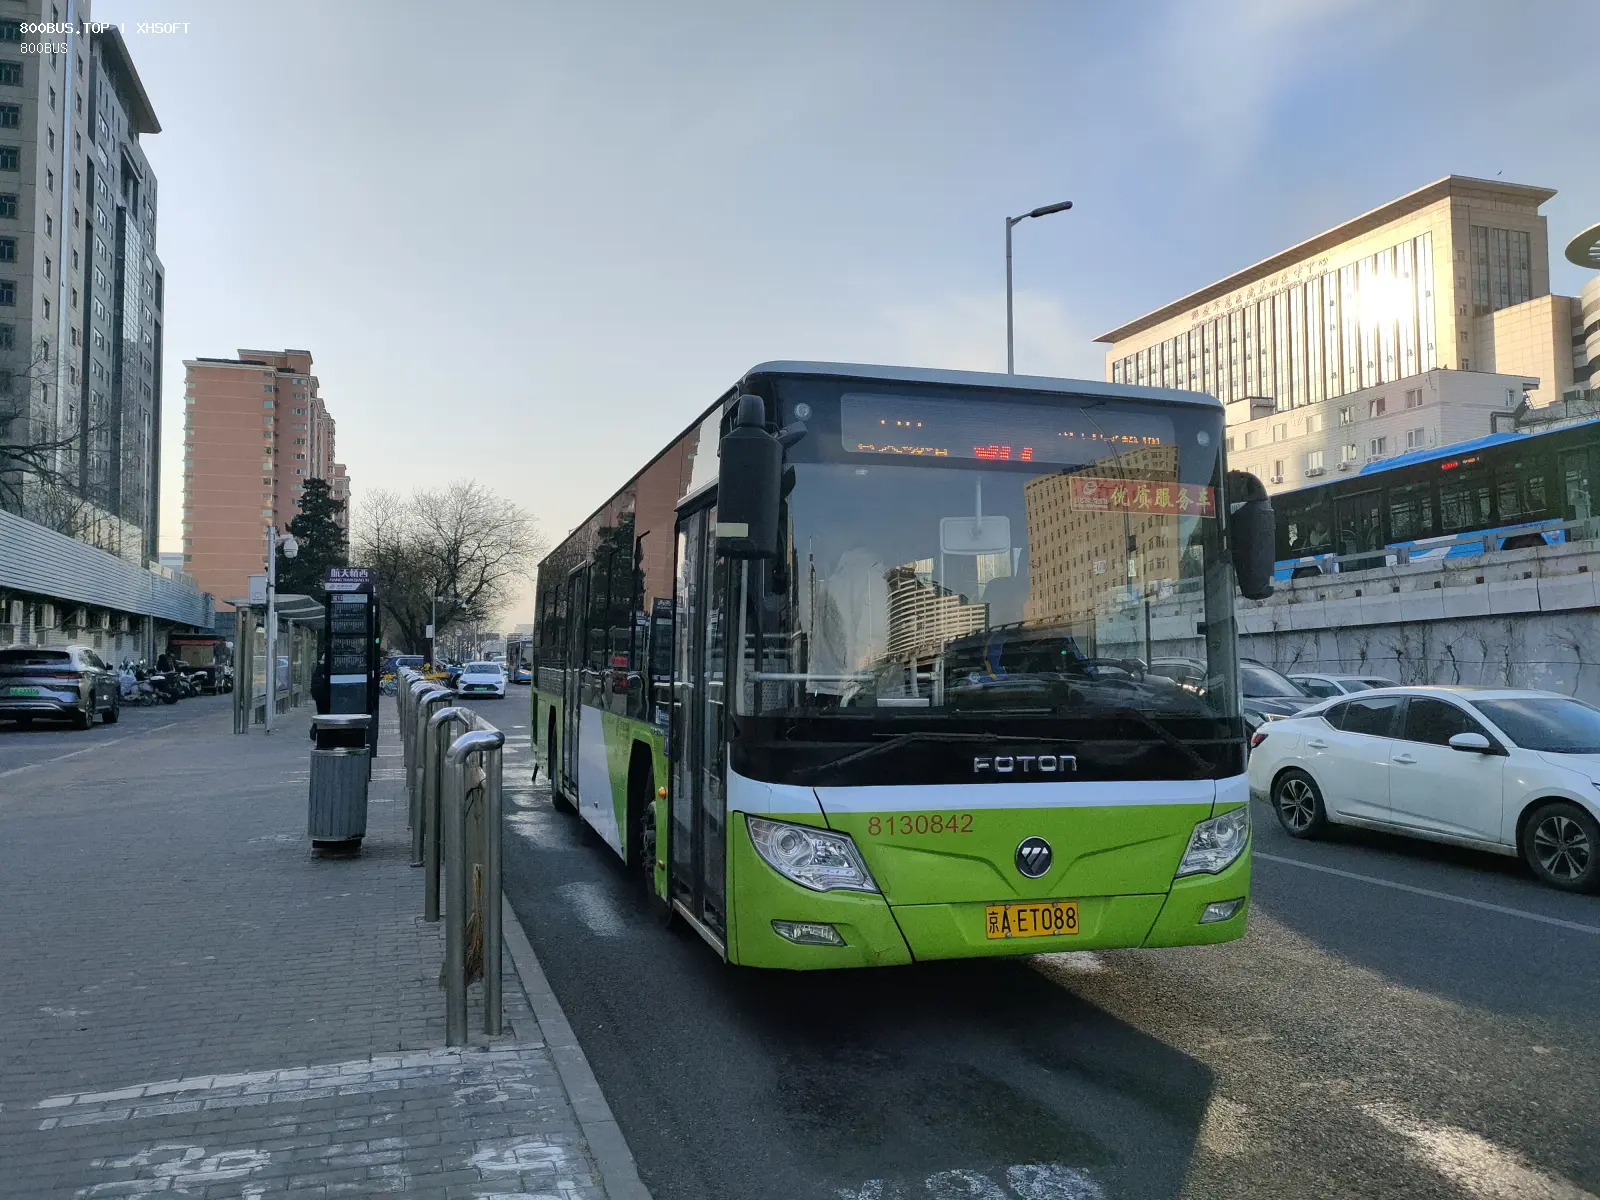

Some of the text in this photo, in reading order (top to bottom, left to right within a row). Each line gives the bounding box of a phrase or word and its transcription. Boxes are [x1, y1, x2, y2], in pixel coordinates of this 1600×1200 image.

[1111, 484, 1212, 514] 优质服务车
[973, 755, 1078, 773] FOTON
[867, 813, 974, 836] 8130842
[987, 906, 1078, 935] 京A·ET088
